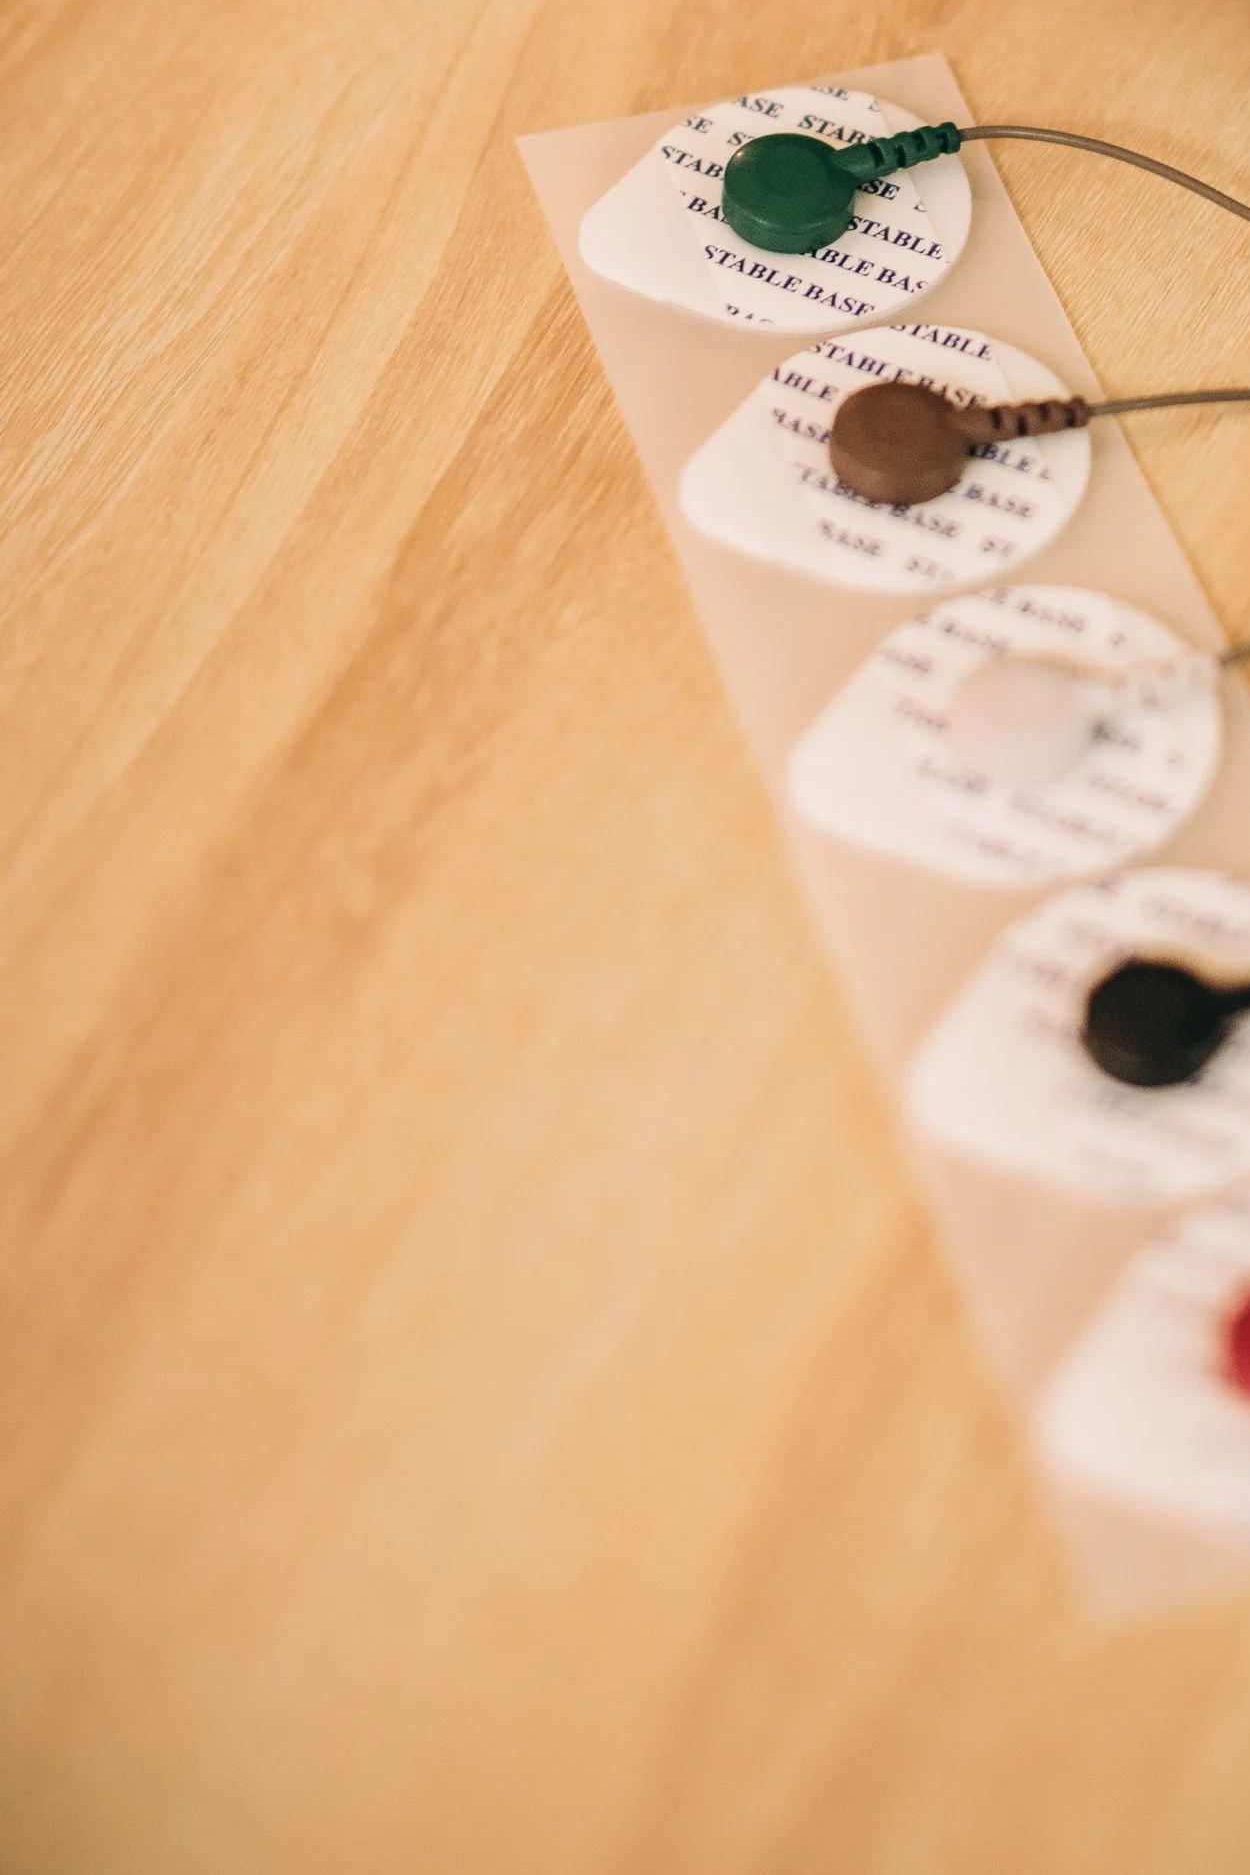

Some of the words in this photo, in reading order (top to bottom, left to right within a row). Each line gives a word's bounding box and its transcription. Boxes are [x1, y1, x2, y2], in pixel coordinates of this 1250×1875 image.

[731, 96, 785, 119] ASE
[660, 145, 725, 181] STAB
[848, 215, 943, 261] STABLE
[704, 244, 803, 293] STABLE
[877, 266, 928, 294] BAS
[771, 367, 839, 402] ABLE
